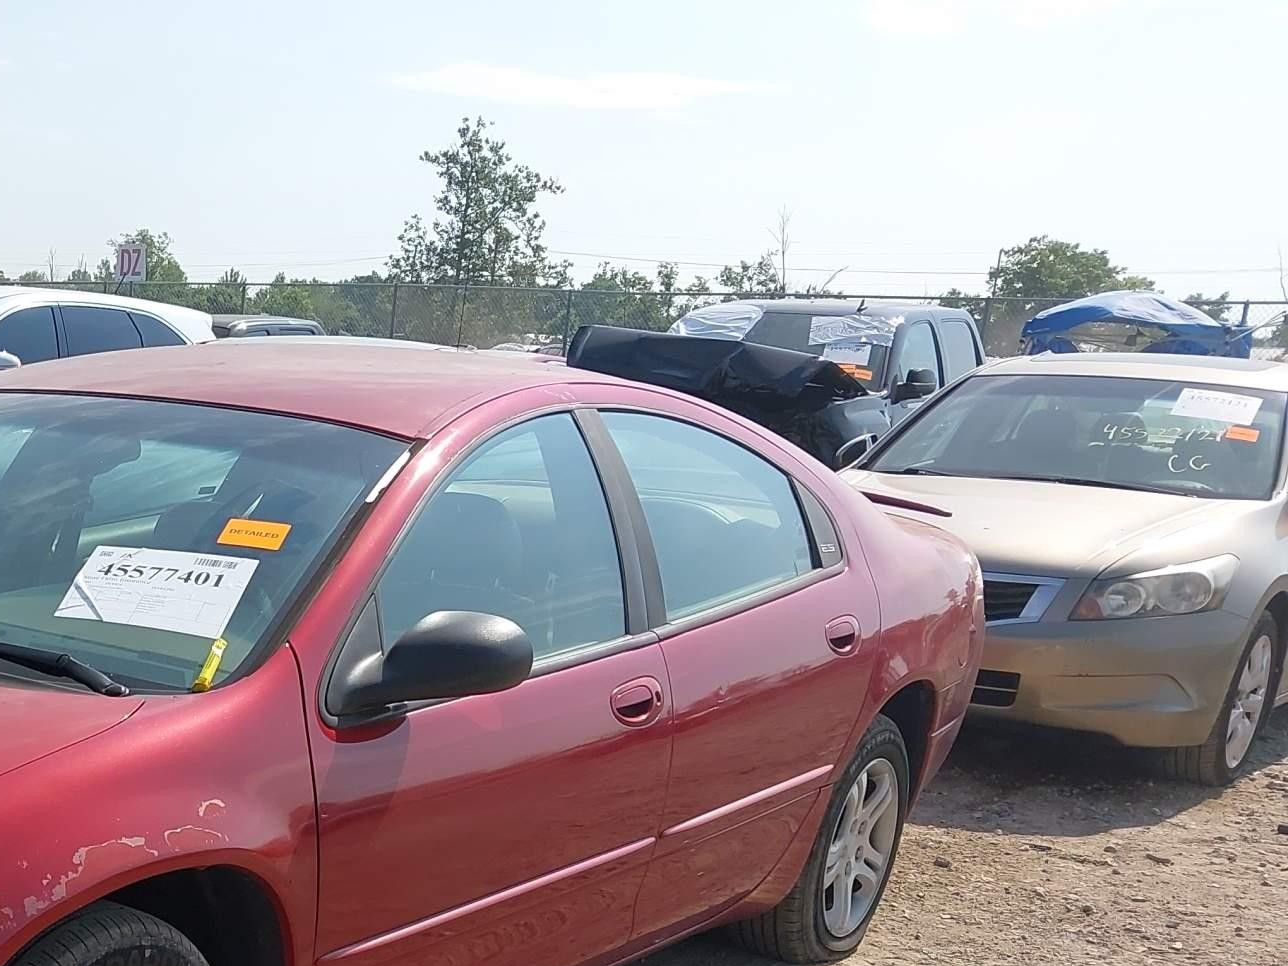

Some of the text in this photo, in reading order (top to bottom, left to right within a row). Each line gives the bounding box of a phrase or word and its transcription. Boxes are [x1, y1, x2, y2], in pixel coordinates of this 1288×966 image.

[119, 248, 142, 277] DZ
[228, 528, 280, 539] DETAILED
[97, 562, 225, 588] 45577401
